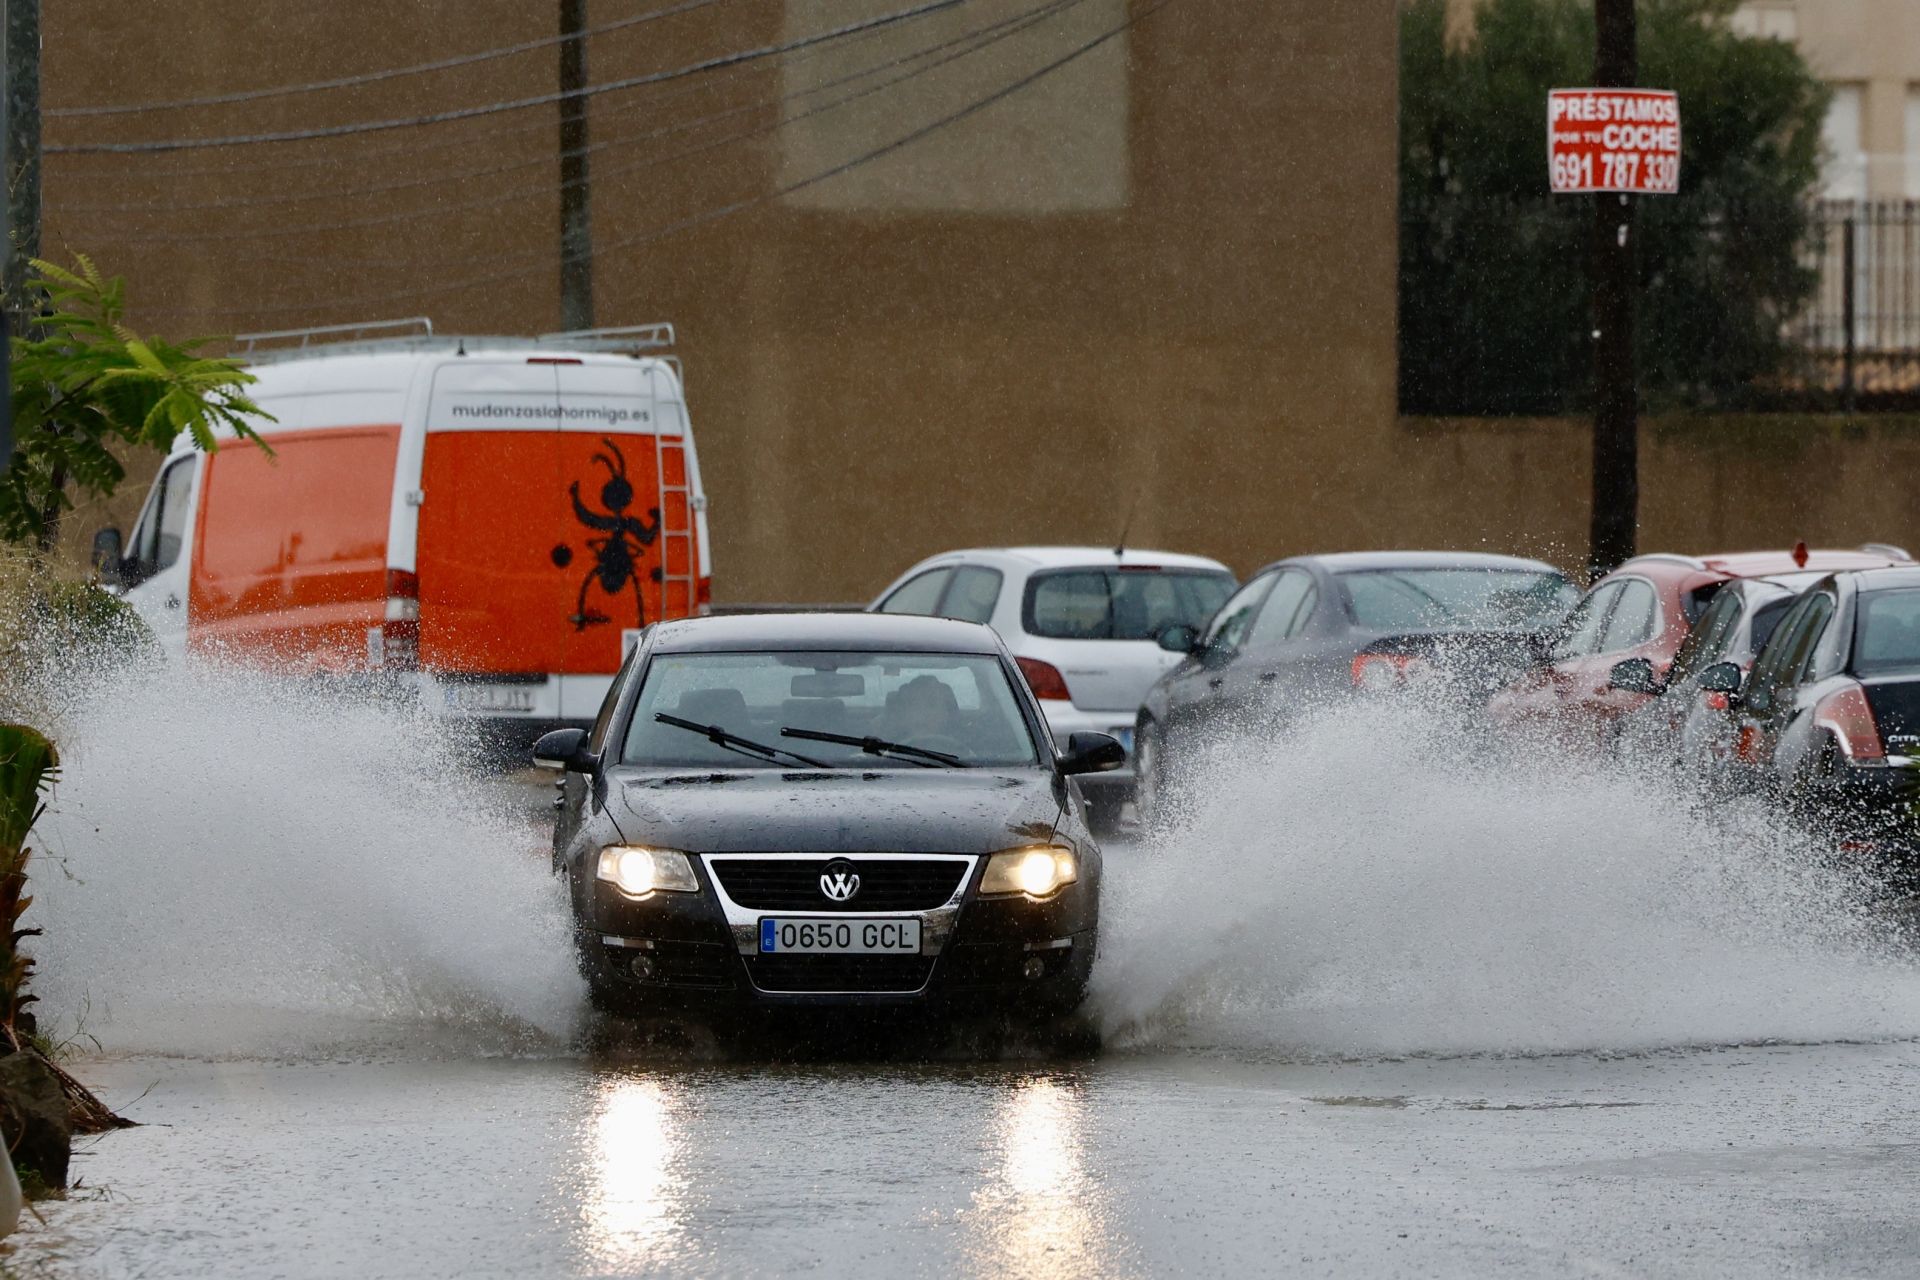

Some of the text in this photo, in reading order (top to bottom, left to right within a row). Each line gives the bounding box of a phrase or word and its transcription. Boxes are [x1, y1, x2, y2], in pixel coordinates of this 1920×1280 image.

[1583, 131, 1602, 144] TU
[1603, 124, 1679, 150] COCHE
[1554, 152, 1678, 190] 691 787 330
[452, 404, 650, 425] mudanzaslahormiga.es
[781, 923, 851, 948] 0650
[863, 923, 914, 948] GCL
